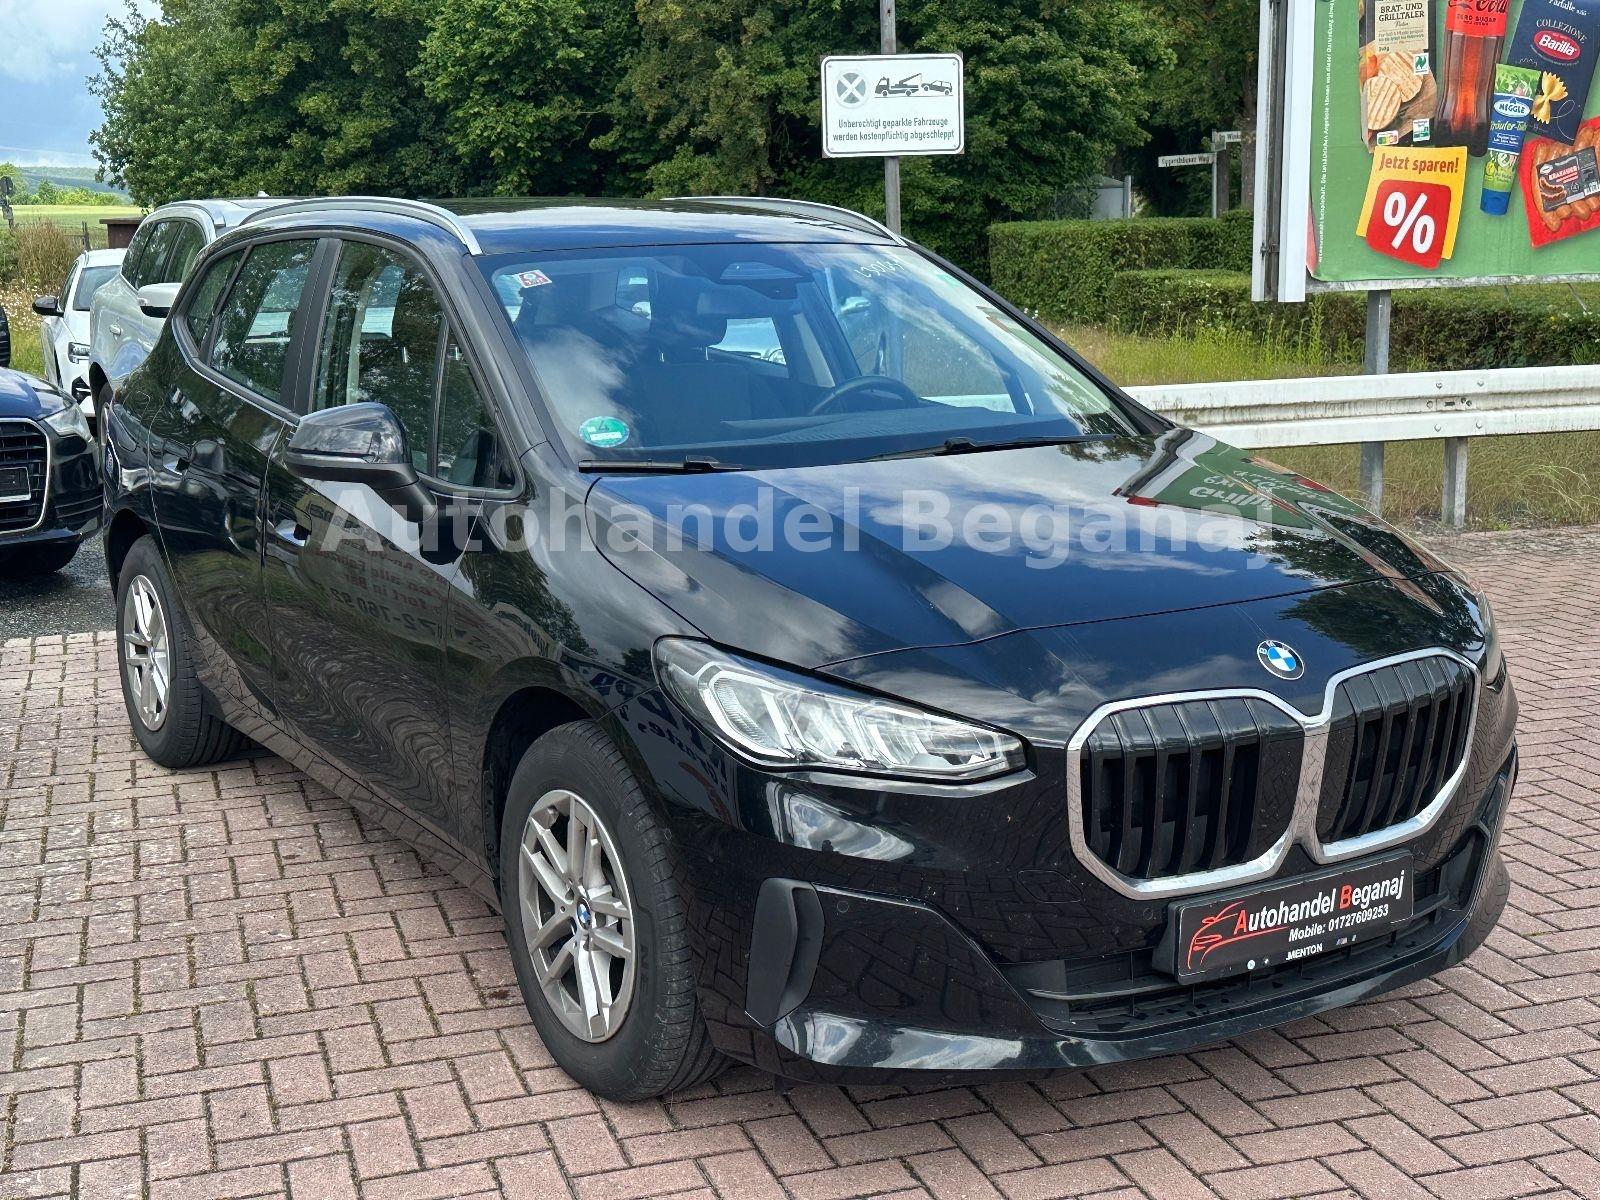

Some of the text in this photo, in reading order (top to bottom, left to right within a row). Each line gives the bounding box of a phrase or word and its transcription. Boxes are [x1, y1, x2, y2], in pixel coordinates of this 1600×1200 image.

[1378, 11, 1425, 21] GRILLTALER
[1380, 3, 1423, 13] BRAT- UND
[1536, 19, 1587, 43] COLLEZIONE
[1539, 34, 1576, 56] Barilla
[1498, 103, 1526, 114] MEGGLE
[838, 117, 949, 129] Unberechtigt geparkte Fahrzeuge
[833, 130, 955, 142] werden kostenpflichtig abgeschleppt
[1379, 153, 1460, 175] Jetzt sparen!
[1383, 191, 1435, 254] %
[1233, 870, 1405, 935] Autohandel Beganaj
[1288, 904, 1389, 943] Mobile: 01727609253
